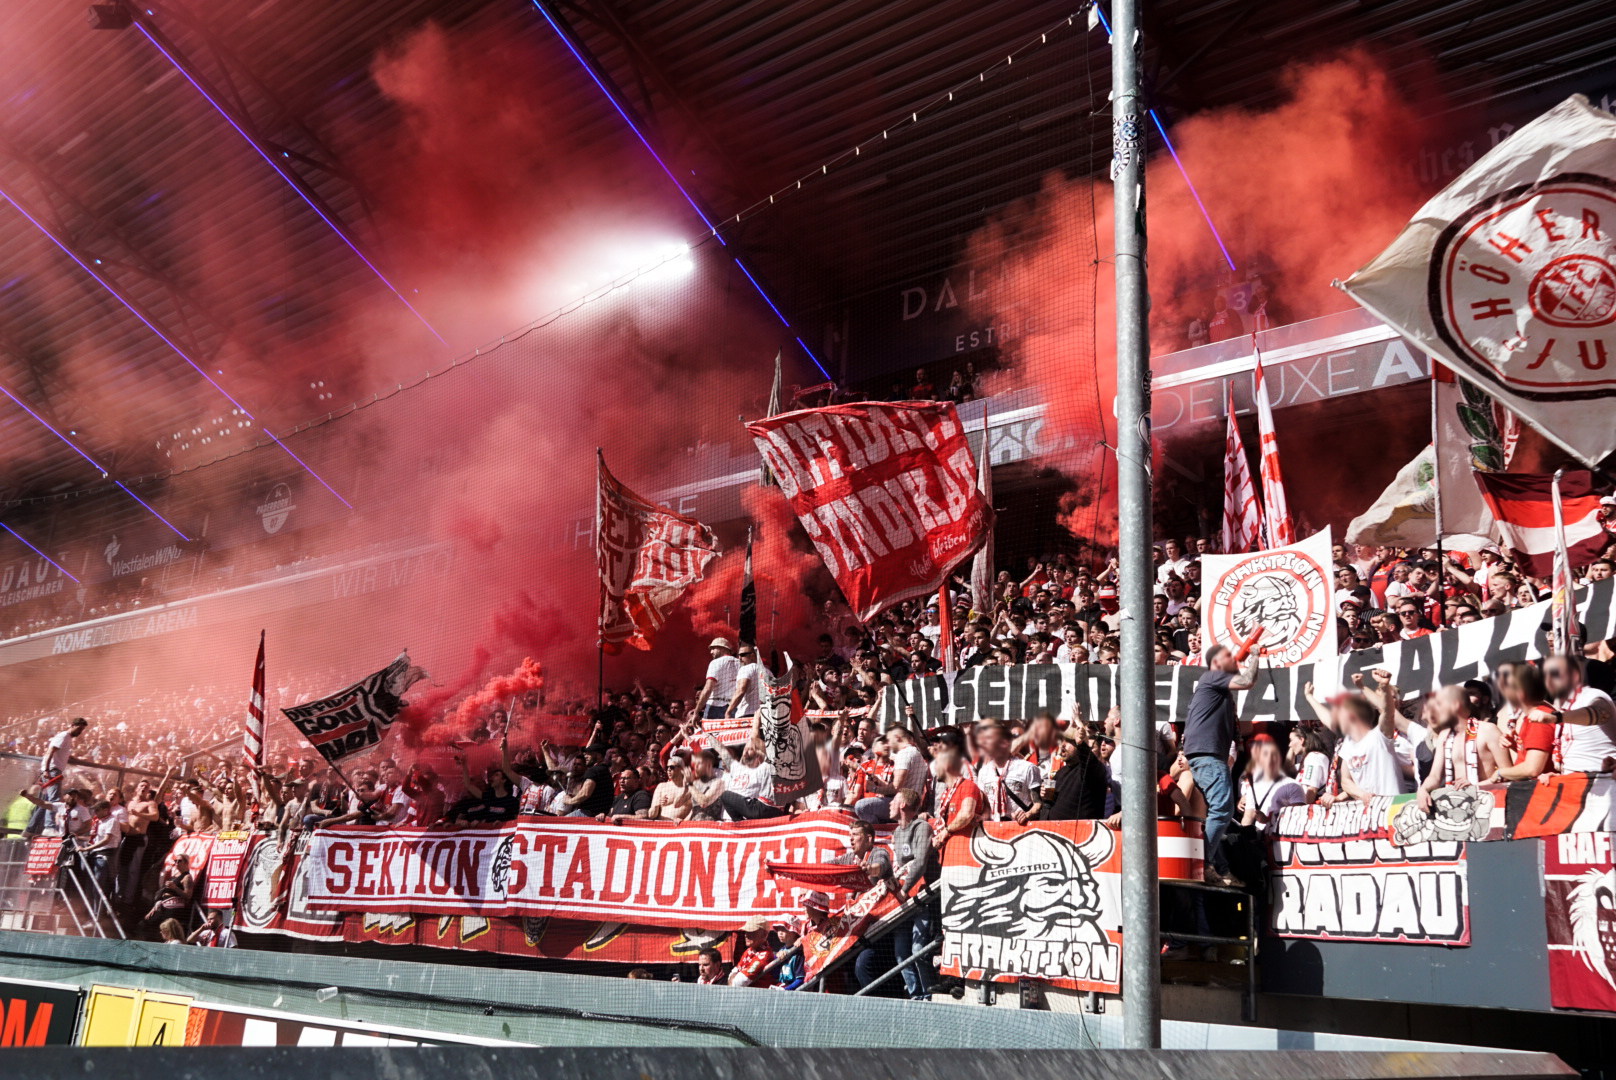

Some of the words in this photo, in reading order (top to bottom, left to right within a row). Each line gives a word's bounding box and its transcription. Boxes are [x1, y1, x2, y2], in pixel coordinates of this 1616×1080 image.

[798, 446, 977, 580] SYNDIKAT
[1215, 552, 1323, 606] FRAKTION
[325, 839, 487, 896] SEKTION
[1271, 872, 1466, 940] RADAU
[942, 930, 1121, 983] FRAKTION
